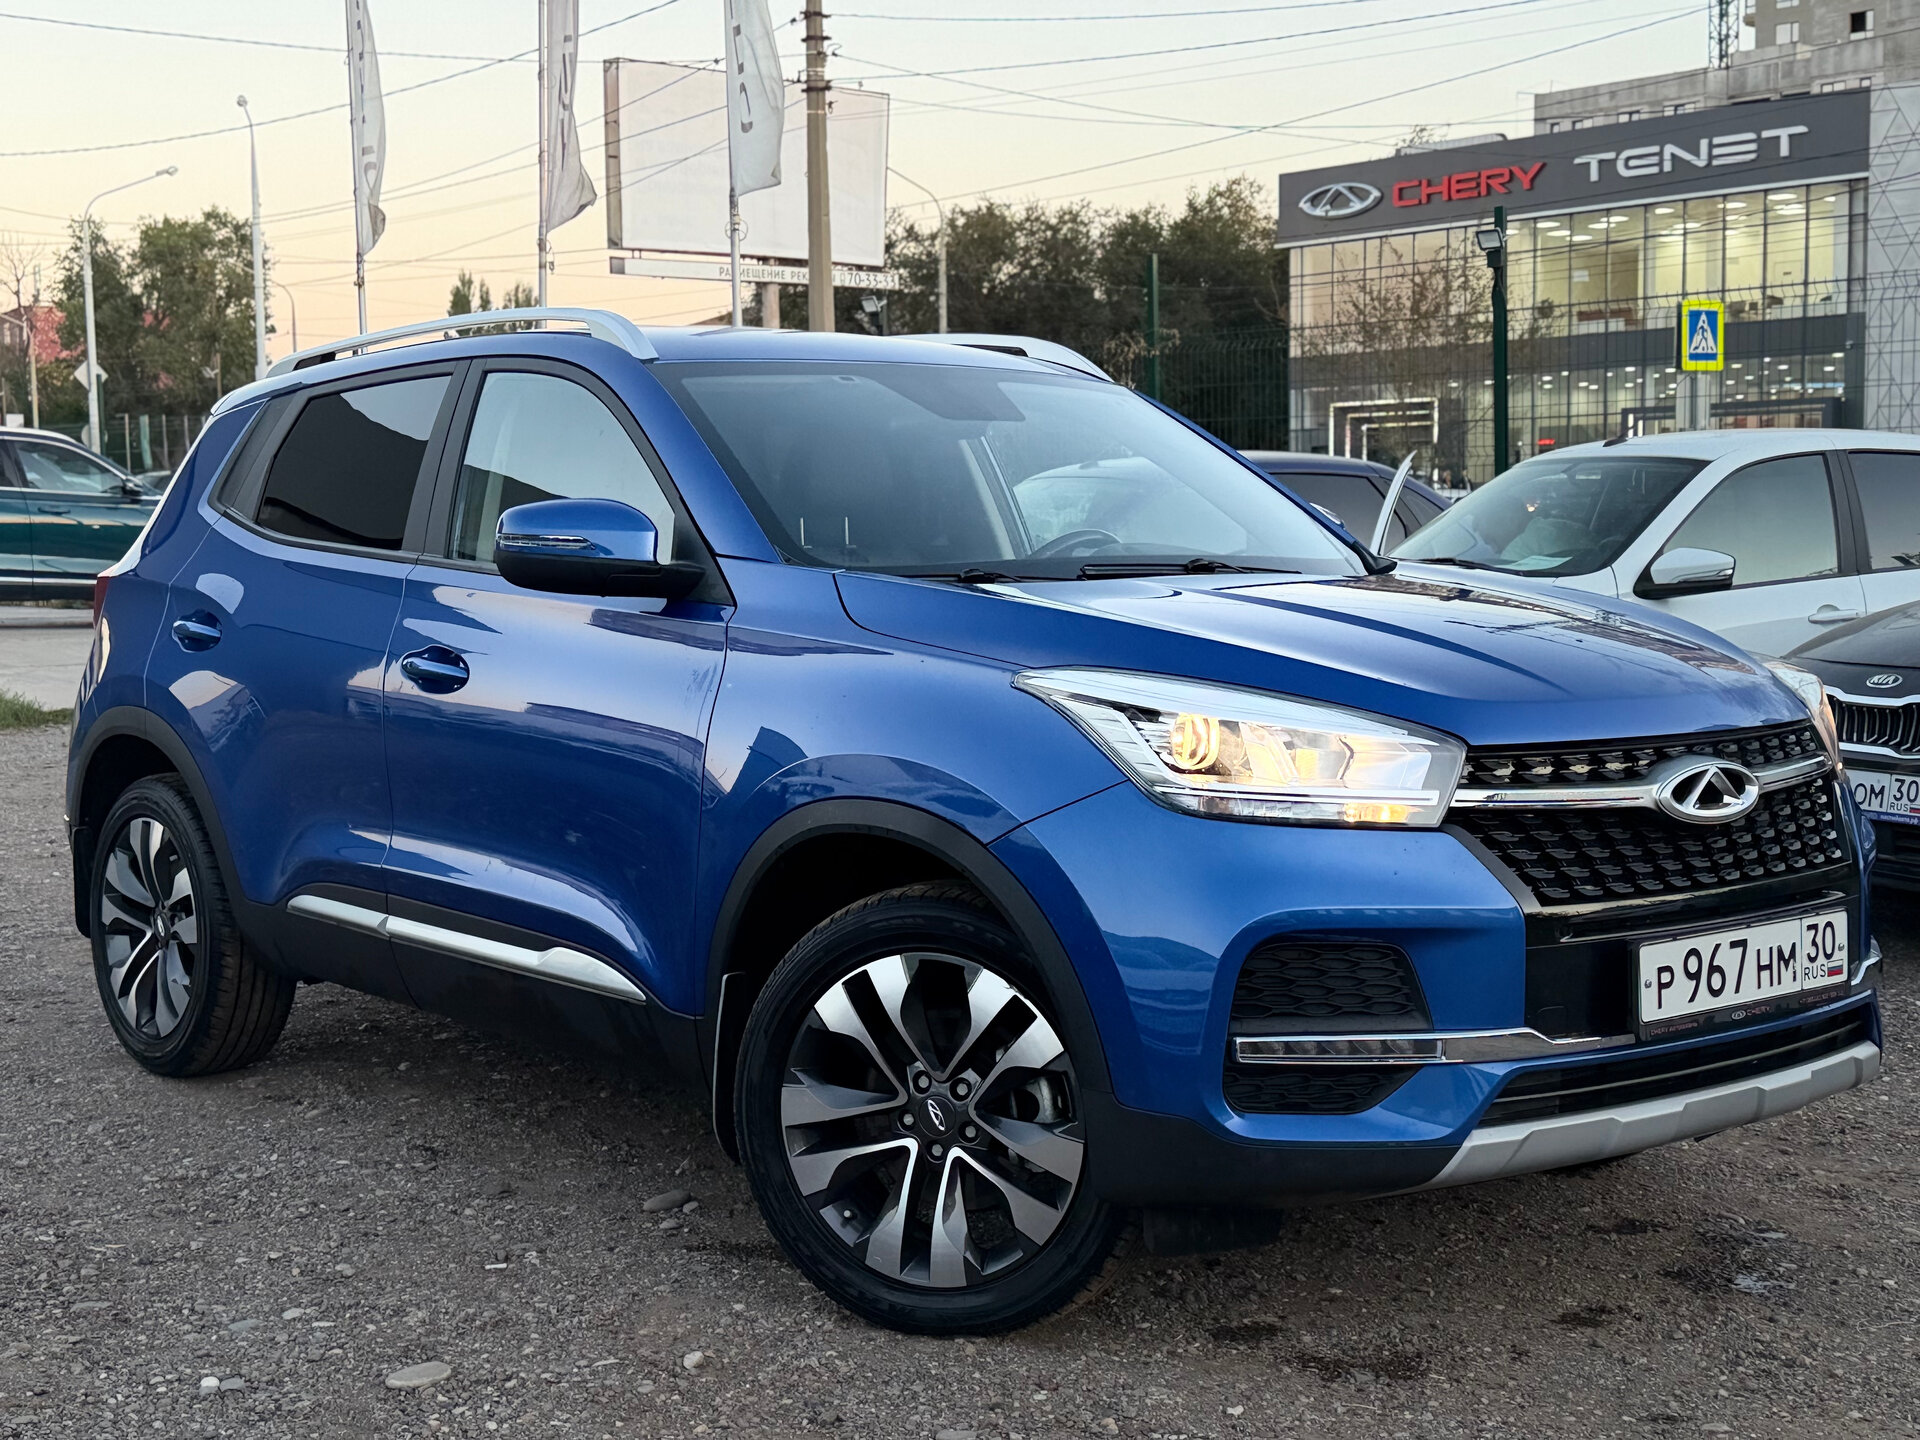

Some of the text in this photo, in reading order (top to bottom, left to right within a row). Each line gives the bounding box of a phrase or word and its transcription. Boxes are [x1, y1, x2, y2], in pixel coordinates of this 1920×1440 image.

[1392, 124, 1810, 208] CHERY TENET
[719, 266, 786, 280] РАМЕЩЕНИЕ
[1870, 674, 1896, 685] KIA
[1892, 778, 1920, 804] 30
[1889, 802, 1909, 813] RUS
[1806, 920, 1836, 964] 30
[1803, 963, 1827, 982] RUS
